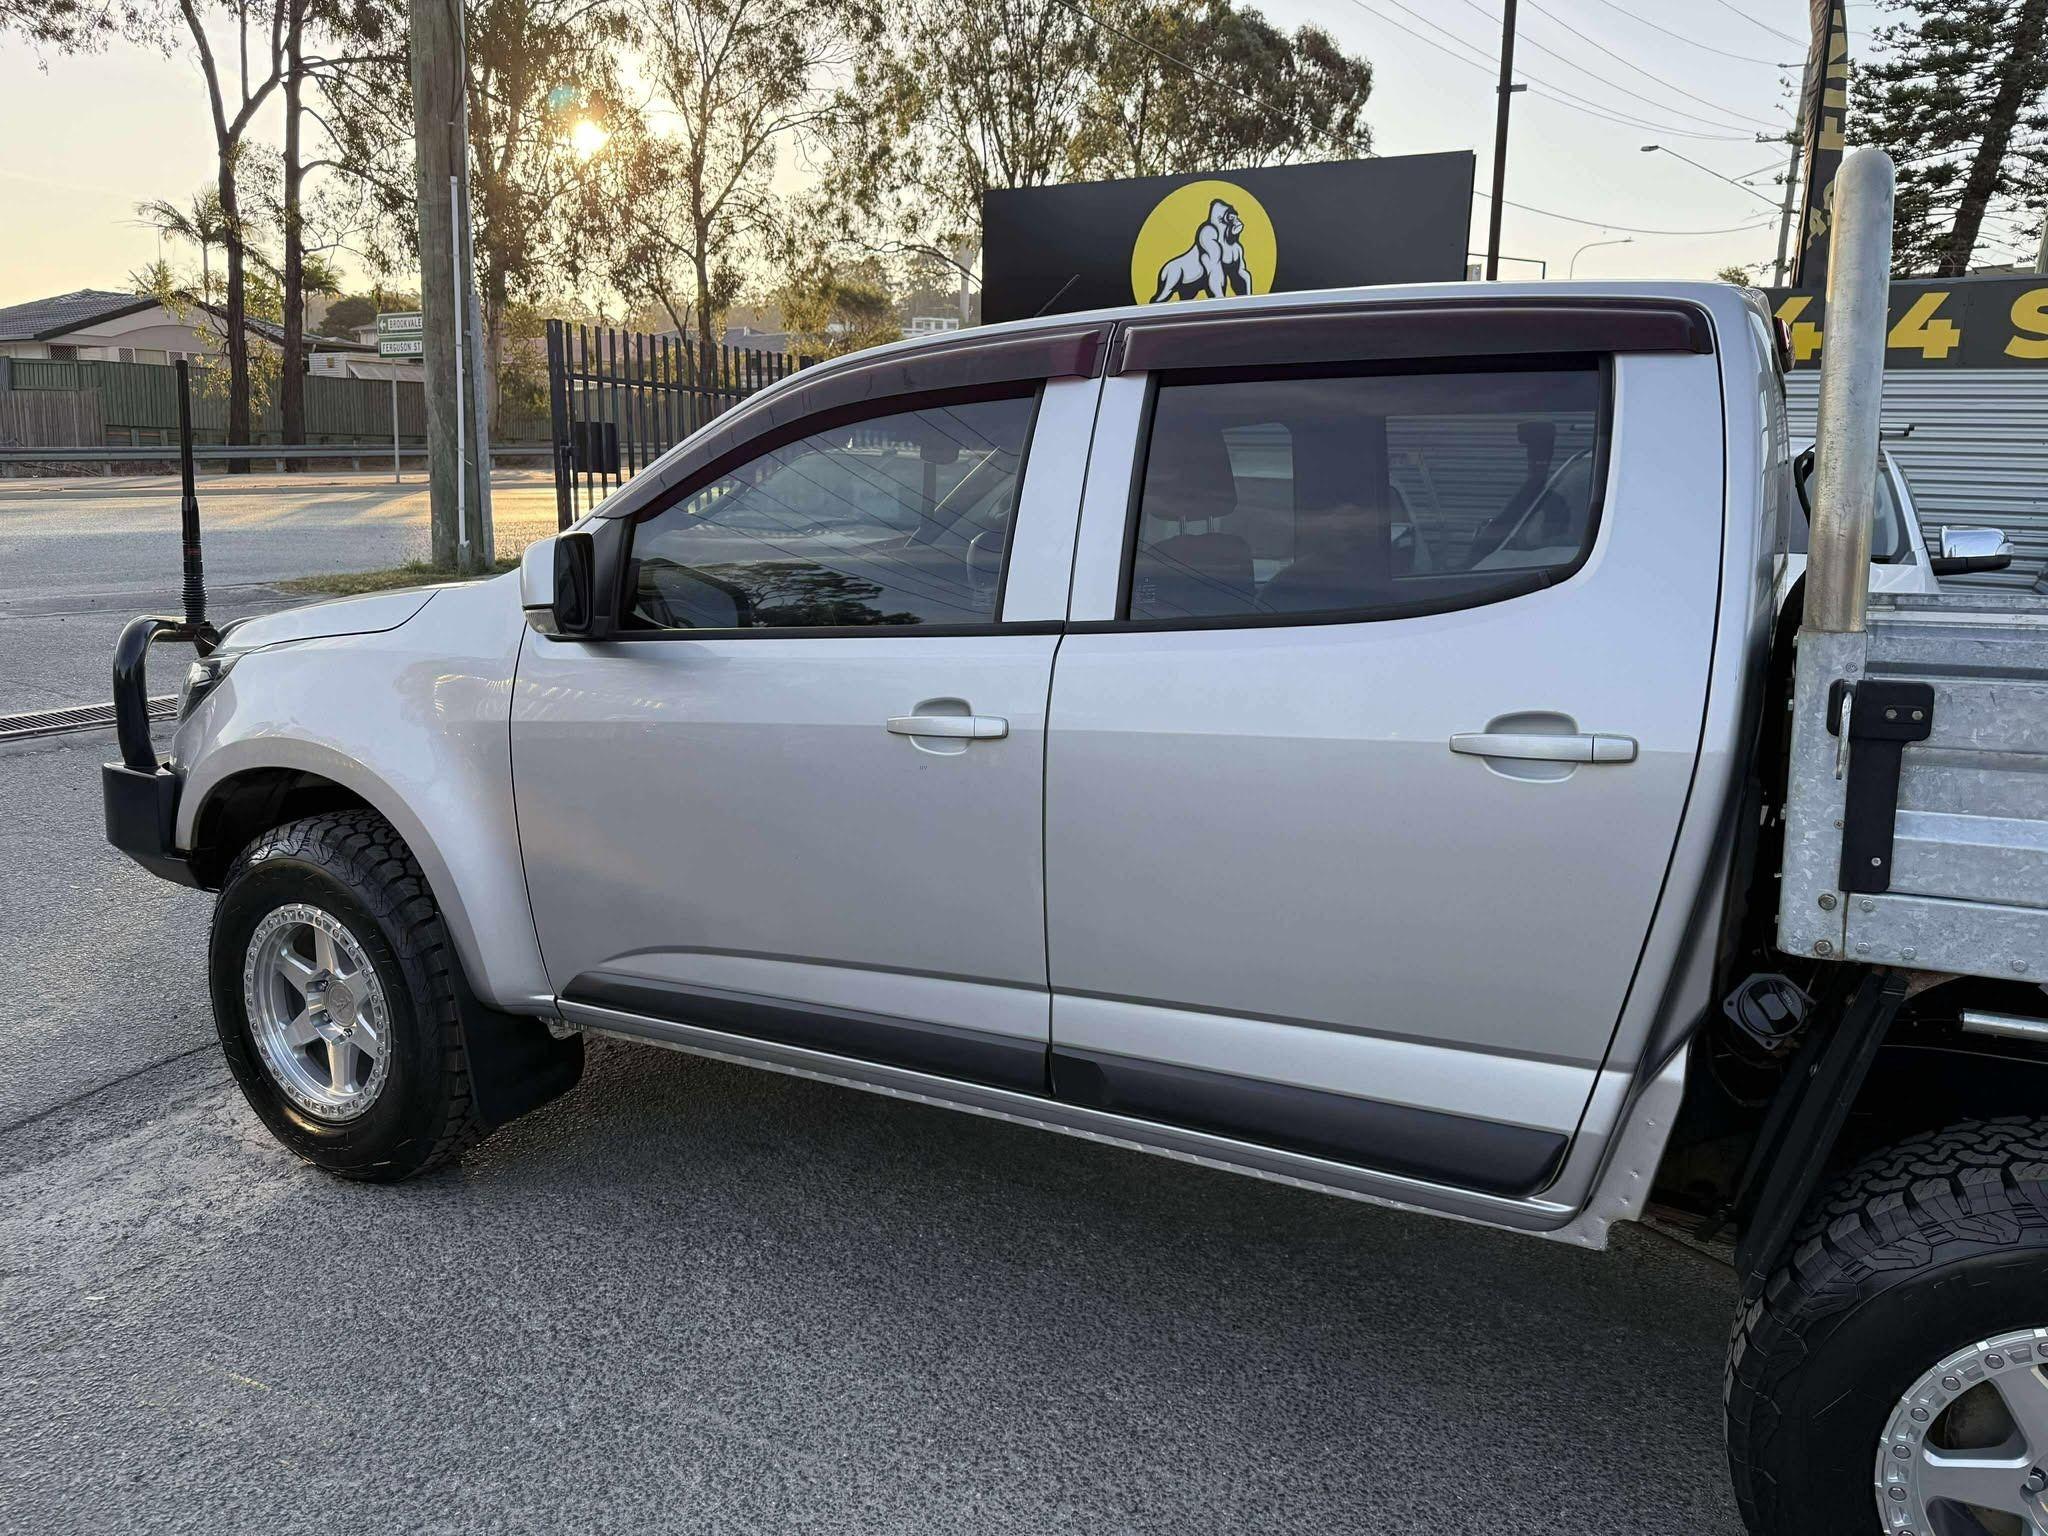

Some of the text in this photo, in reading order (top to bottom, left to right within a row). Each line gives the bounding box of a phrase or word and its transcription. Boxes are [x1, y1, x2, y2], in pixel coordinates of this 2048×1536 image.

[389, 318, 422, 329] BROOKVALE
[1774, 292, 1960, 360] 44
[382, 342, 421, 352] FERGUSON ST
